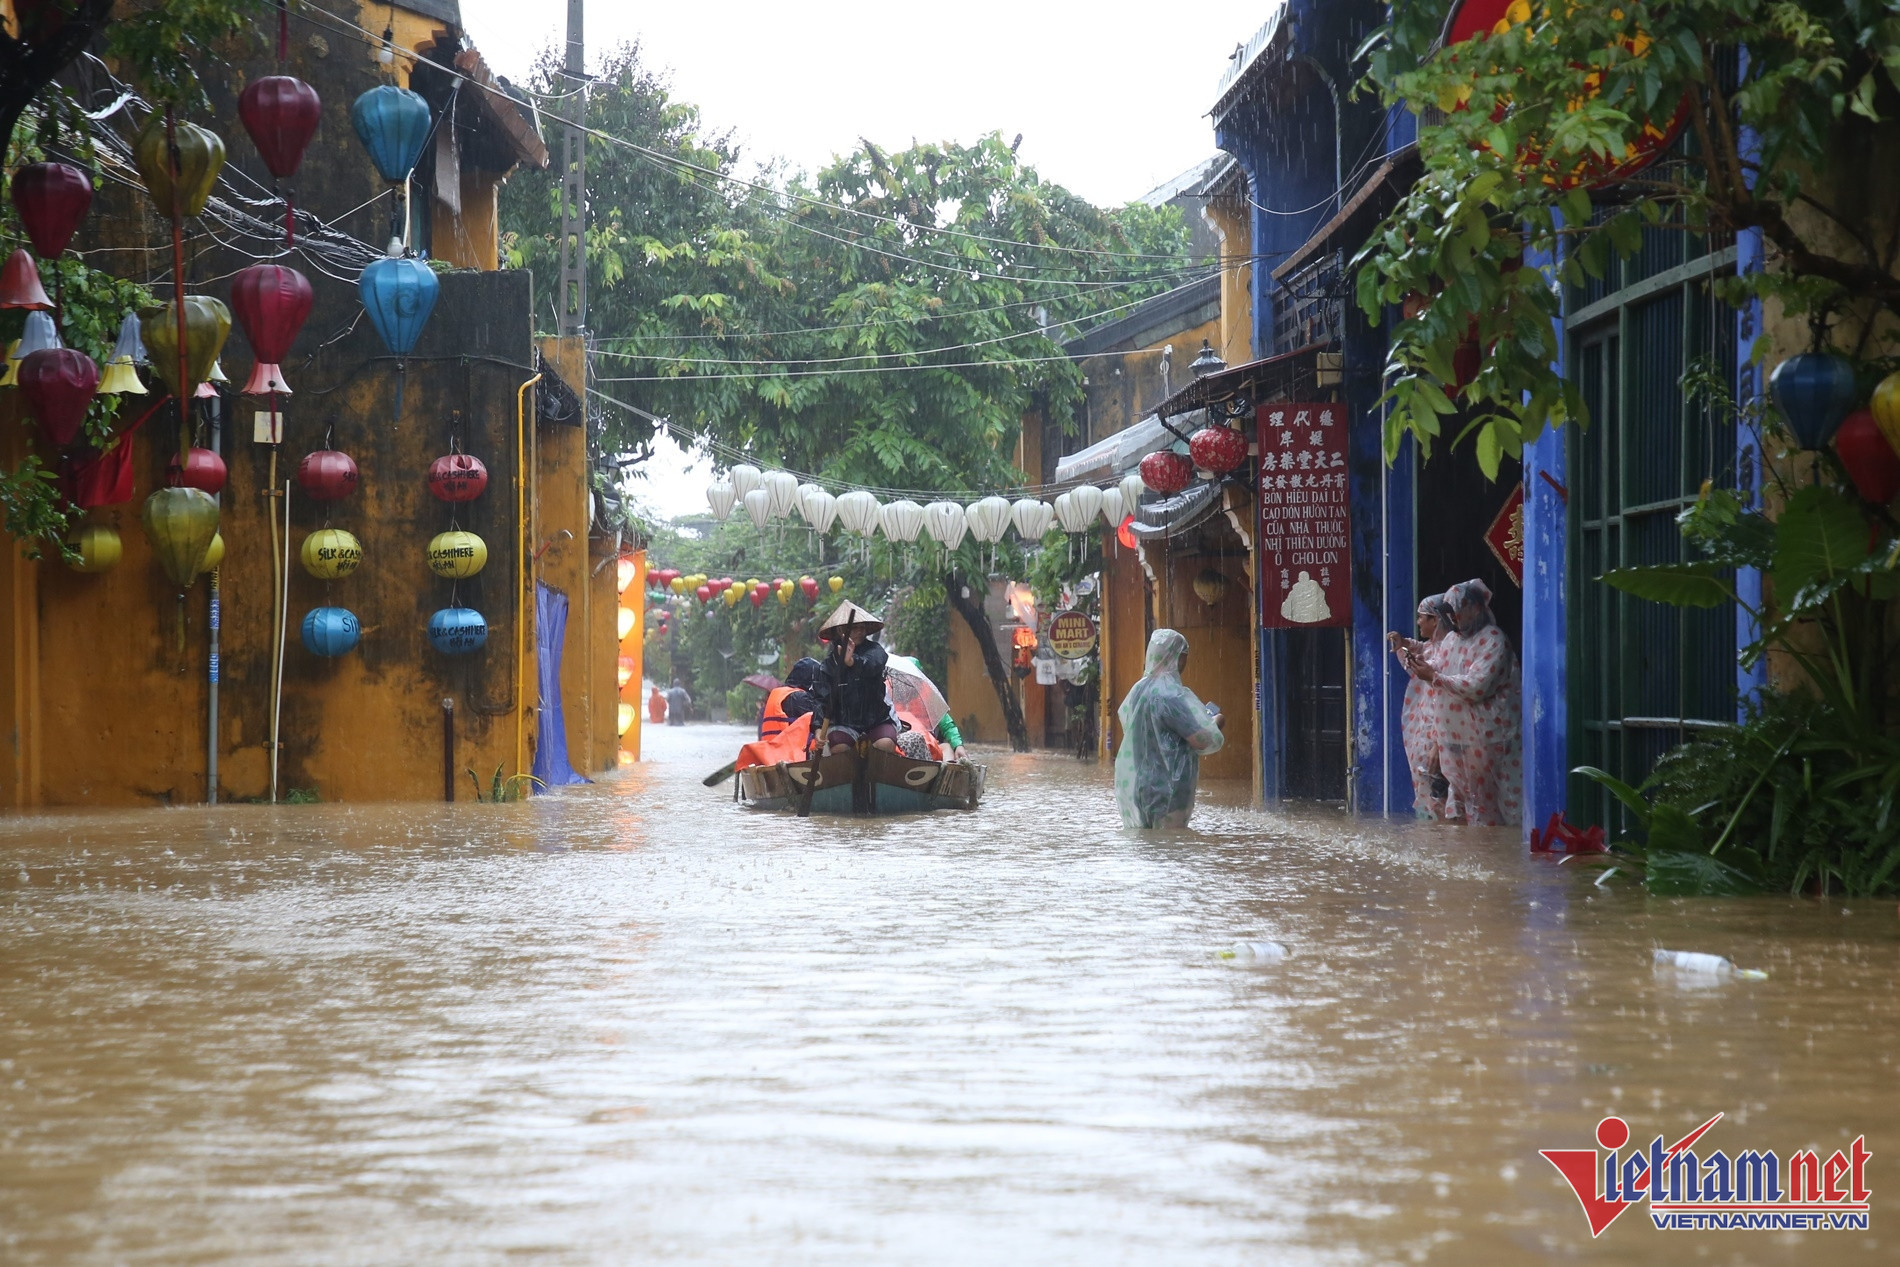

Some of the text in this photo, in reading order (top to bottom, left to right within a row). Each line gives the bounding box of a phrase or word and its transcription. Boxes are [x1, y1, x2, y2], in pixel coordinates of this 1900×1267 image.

[1263, 507, 1280, 519] CAO
[1292, 551, 1338, 565] CHOLON
[1058, 618, 1086, 628] MINI
[1056, 629, 1088, 639] MART
